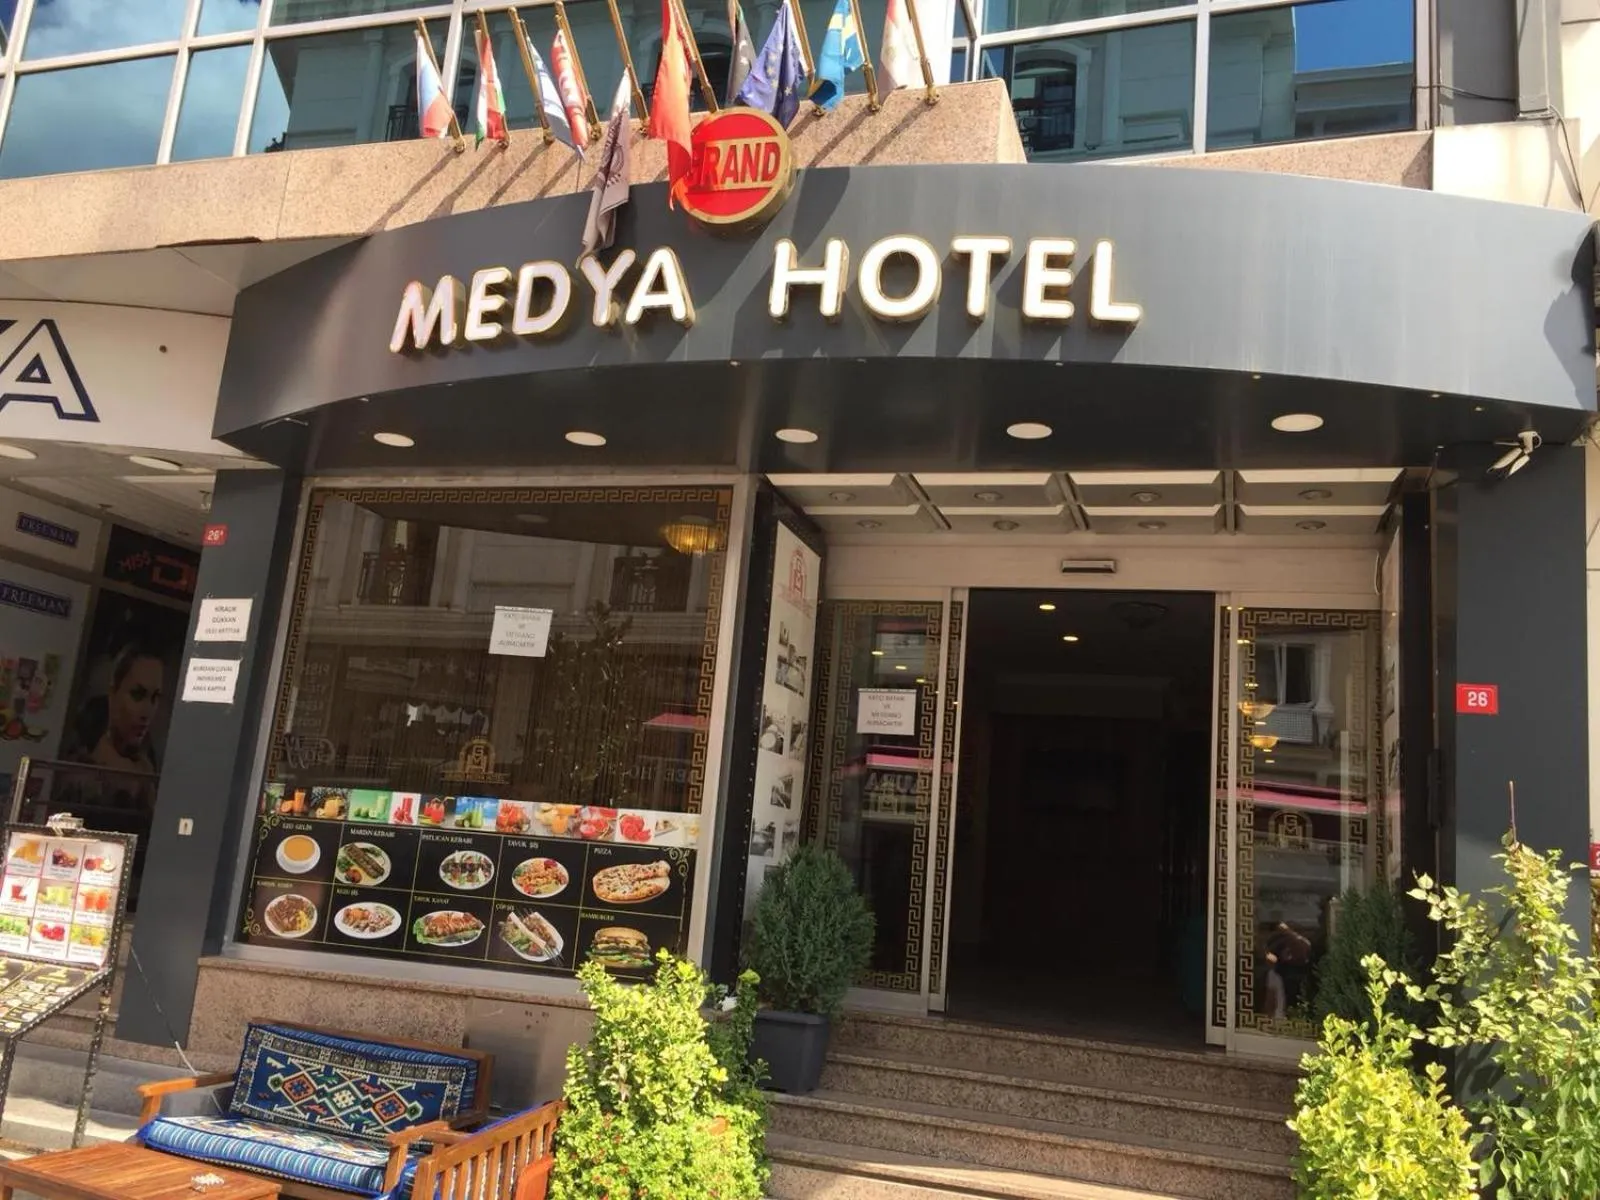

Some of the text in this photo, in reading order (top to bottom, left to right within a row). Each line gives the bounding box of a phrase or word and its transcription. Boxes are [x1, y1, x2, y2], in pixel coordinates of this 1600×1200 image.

[389, 234, 1143, 354] MEDYA HOTEL
[20, 516, 76, 545] FREEMAN
[2, 585, 69, 615] FREEMAN
[1467, 690, 1489, 708] 26
